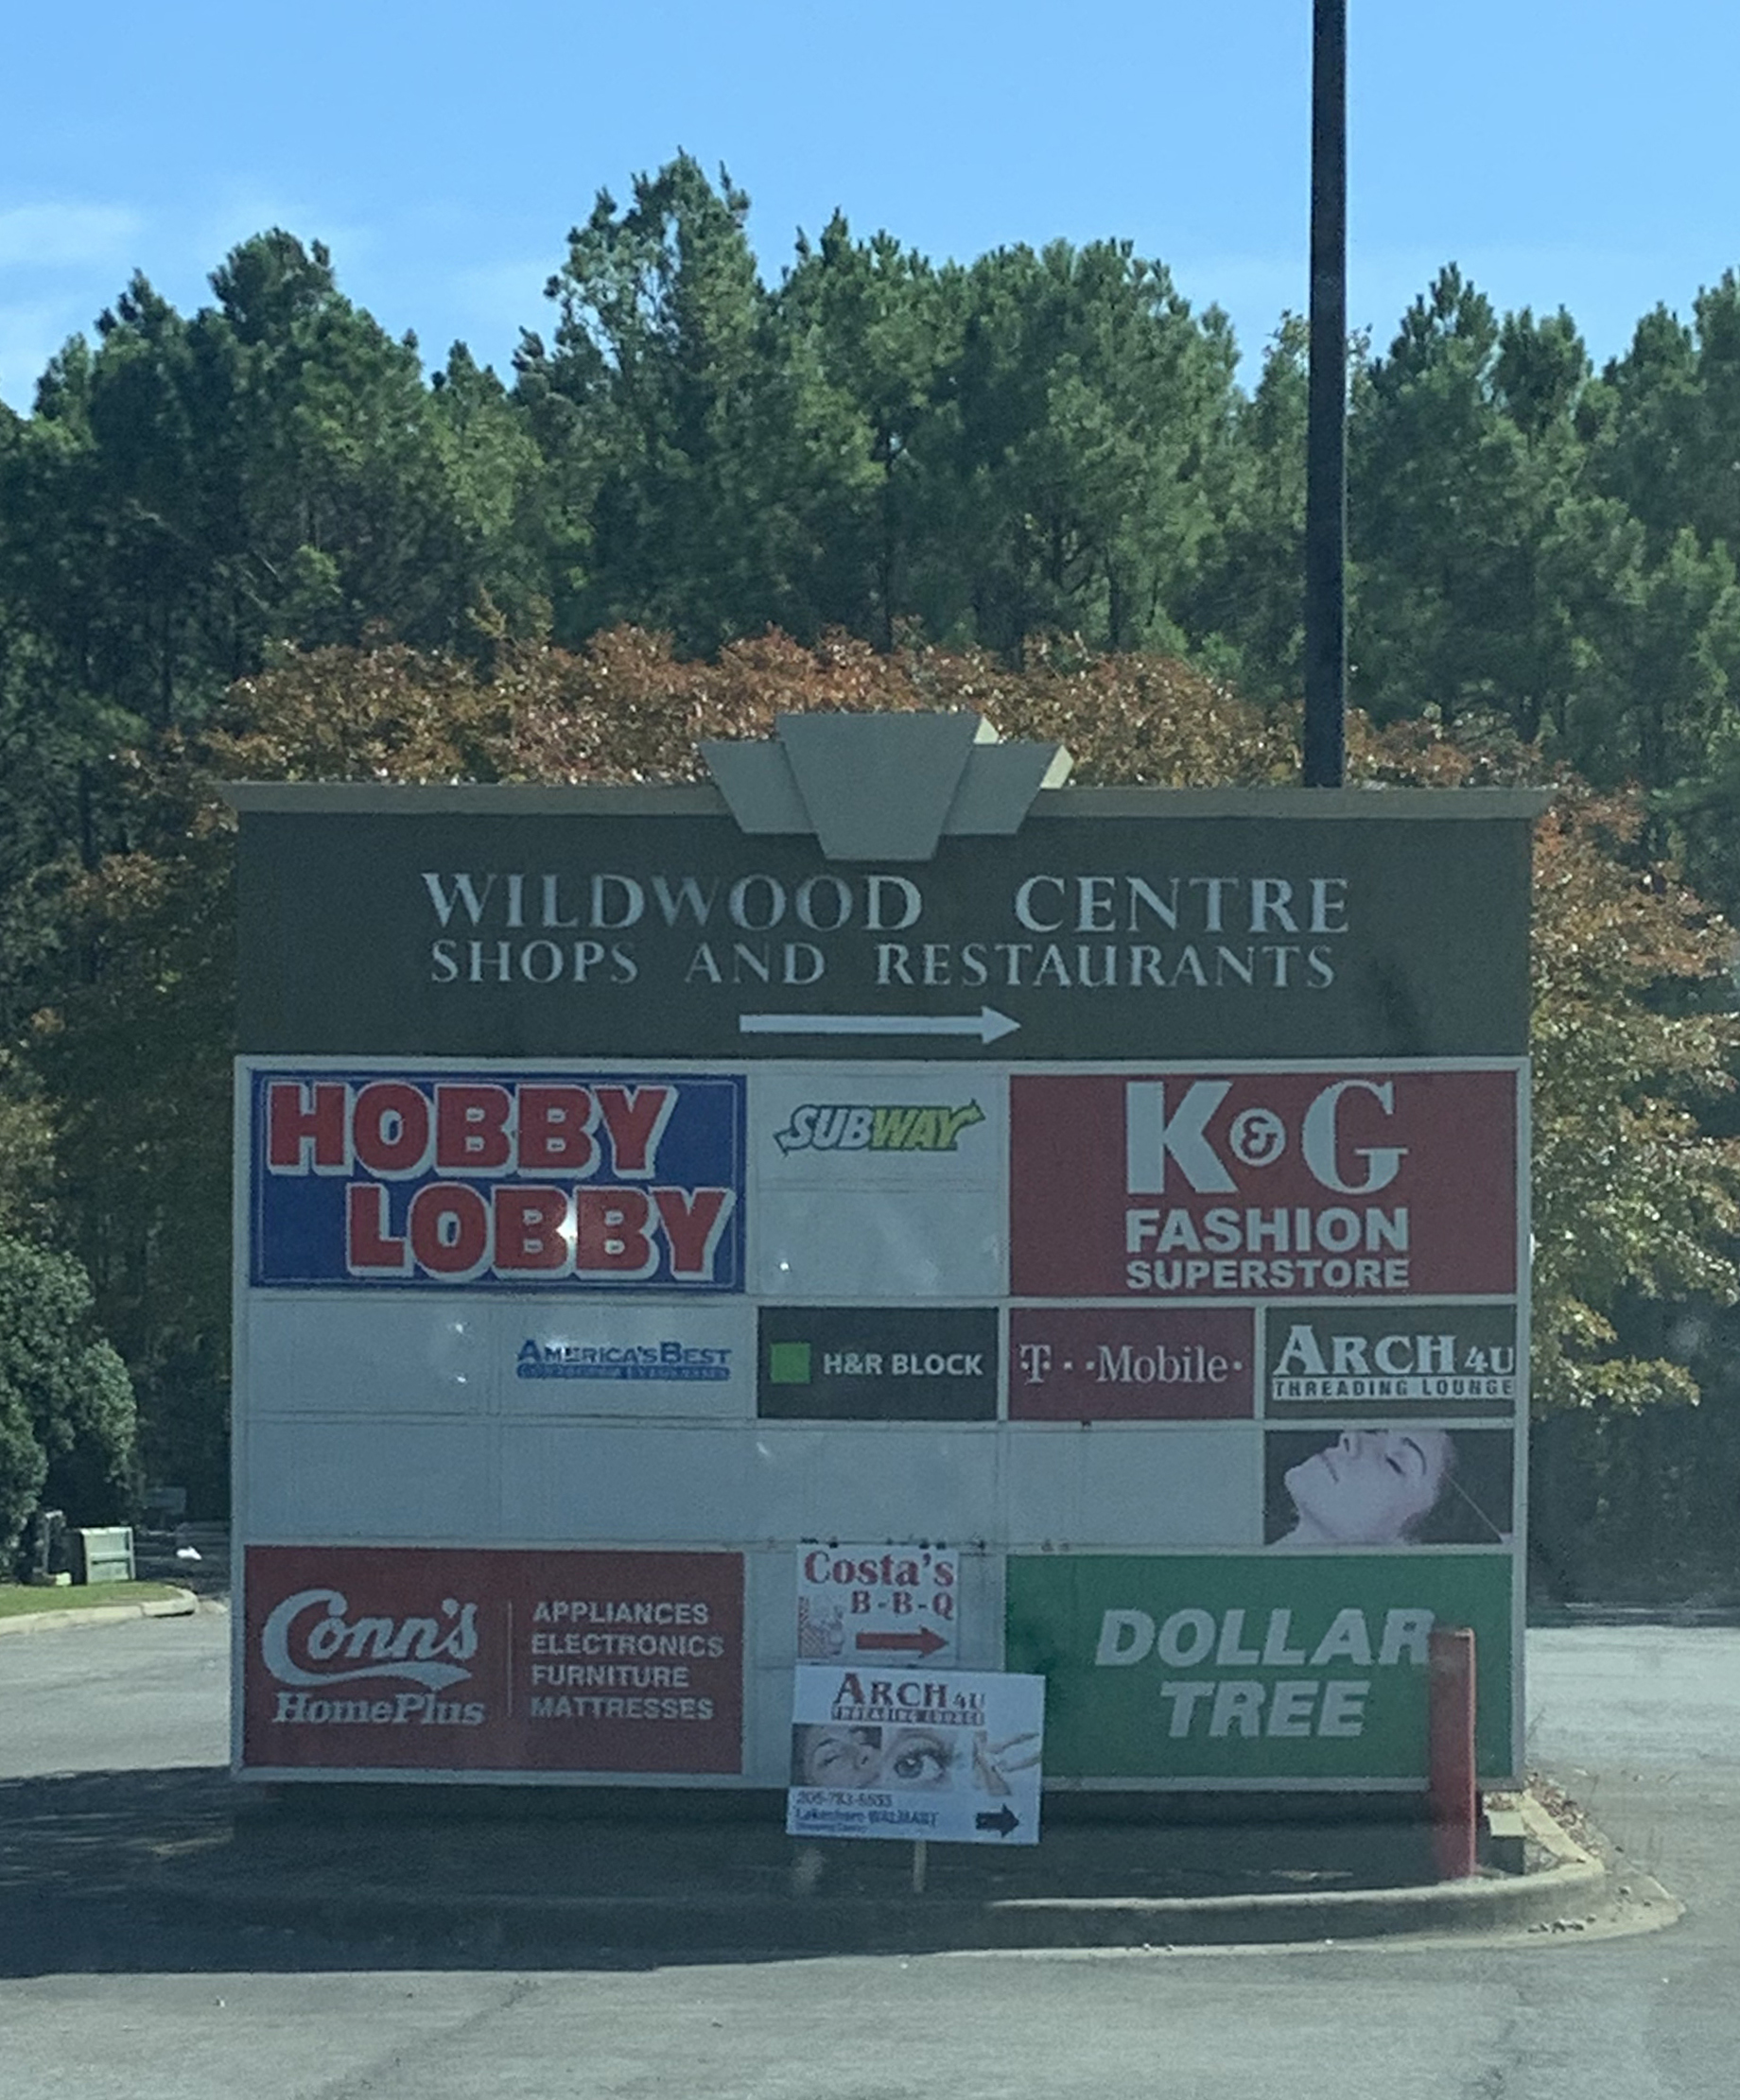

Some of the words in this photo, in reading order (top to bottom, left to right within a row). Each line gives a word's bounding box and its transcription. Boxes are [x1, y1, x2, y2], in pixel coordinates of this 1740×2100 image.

[421, 872, 923, 932] WILDWOOD
[1015, 875, 1349, 934] CENTRE
[430, 939, 638, 984] SHOPS
[684, 943, 826, 985] AND
[874, 944, 1335, 989] RESTAURANTS
[268, 1081, 678, 1180] HOBBY
[773, 1099, 985, 1157] SUBWAY
[346, 1181, 736, 1280] LOBBY
[1126, 1207, 1409, 1253] FASHION
[1125, 1259, 1410, 1290] SUPERSTORE
[660, 1341, 732, 1364] BEST
[823, 1353, 883, 1376] H&R
[891, 1354, 983, 1376] BLOCK
[1273, 1325, 1457, 1375] ARCH
[1276, 1379, 1409, 1397] THREADING
[1421, 1378, 1514, 1397] LOUNGE
[804, 1550, 955, 1588] Costa's
[532, 1601, 710, 1625] APPLIANCES
[851, 1589, 954, 1622] B-B-Q
[262, 1588, 478, 1687] Conn's
[531, 1633, 725, 1657] ELECTRONICS
[1094, 1608, 1436, 1667] DOLLAR
[531, 1664, 689, 1689] FURNITURE
[832, 1672, 948, 1709] ARCH
[272, 1691, 486, 1727] HomePlus
[530, 1695, 715, 1722] MATTRESSES
[1160, 1679, 1372, 1738] TREE
